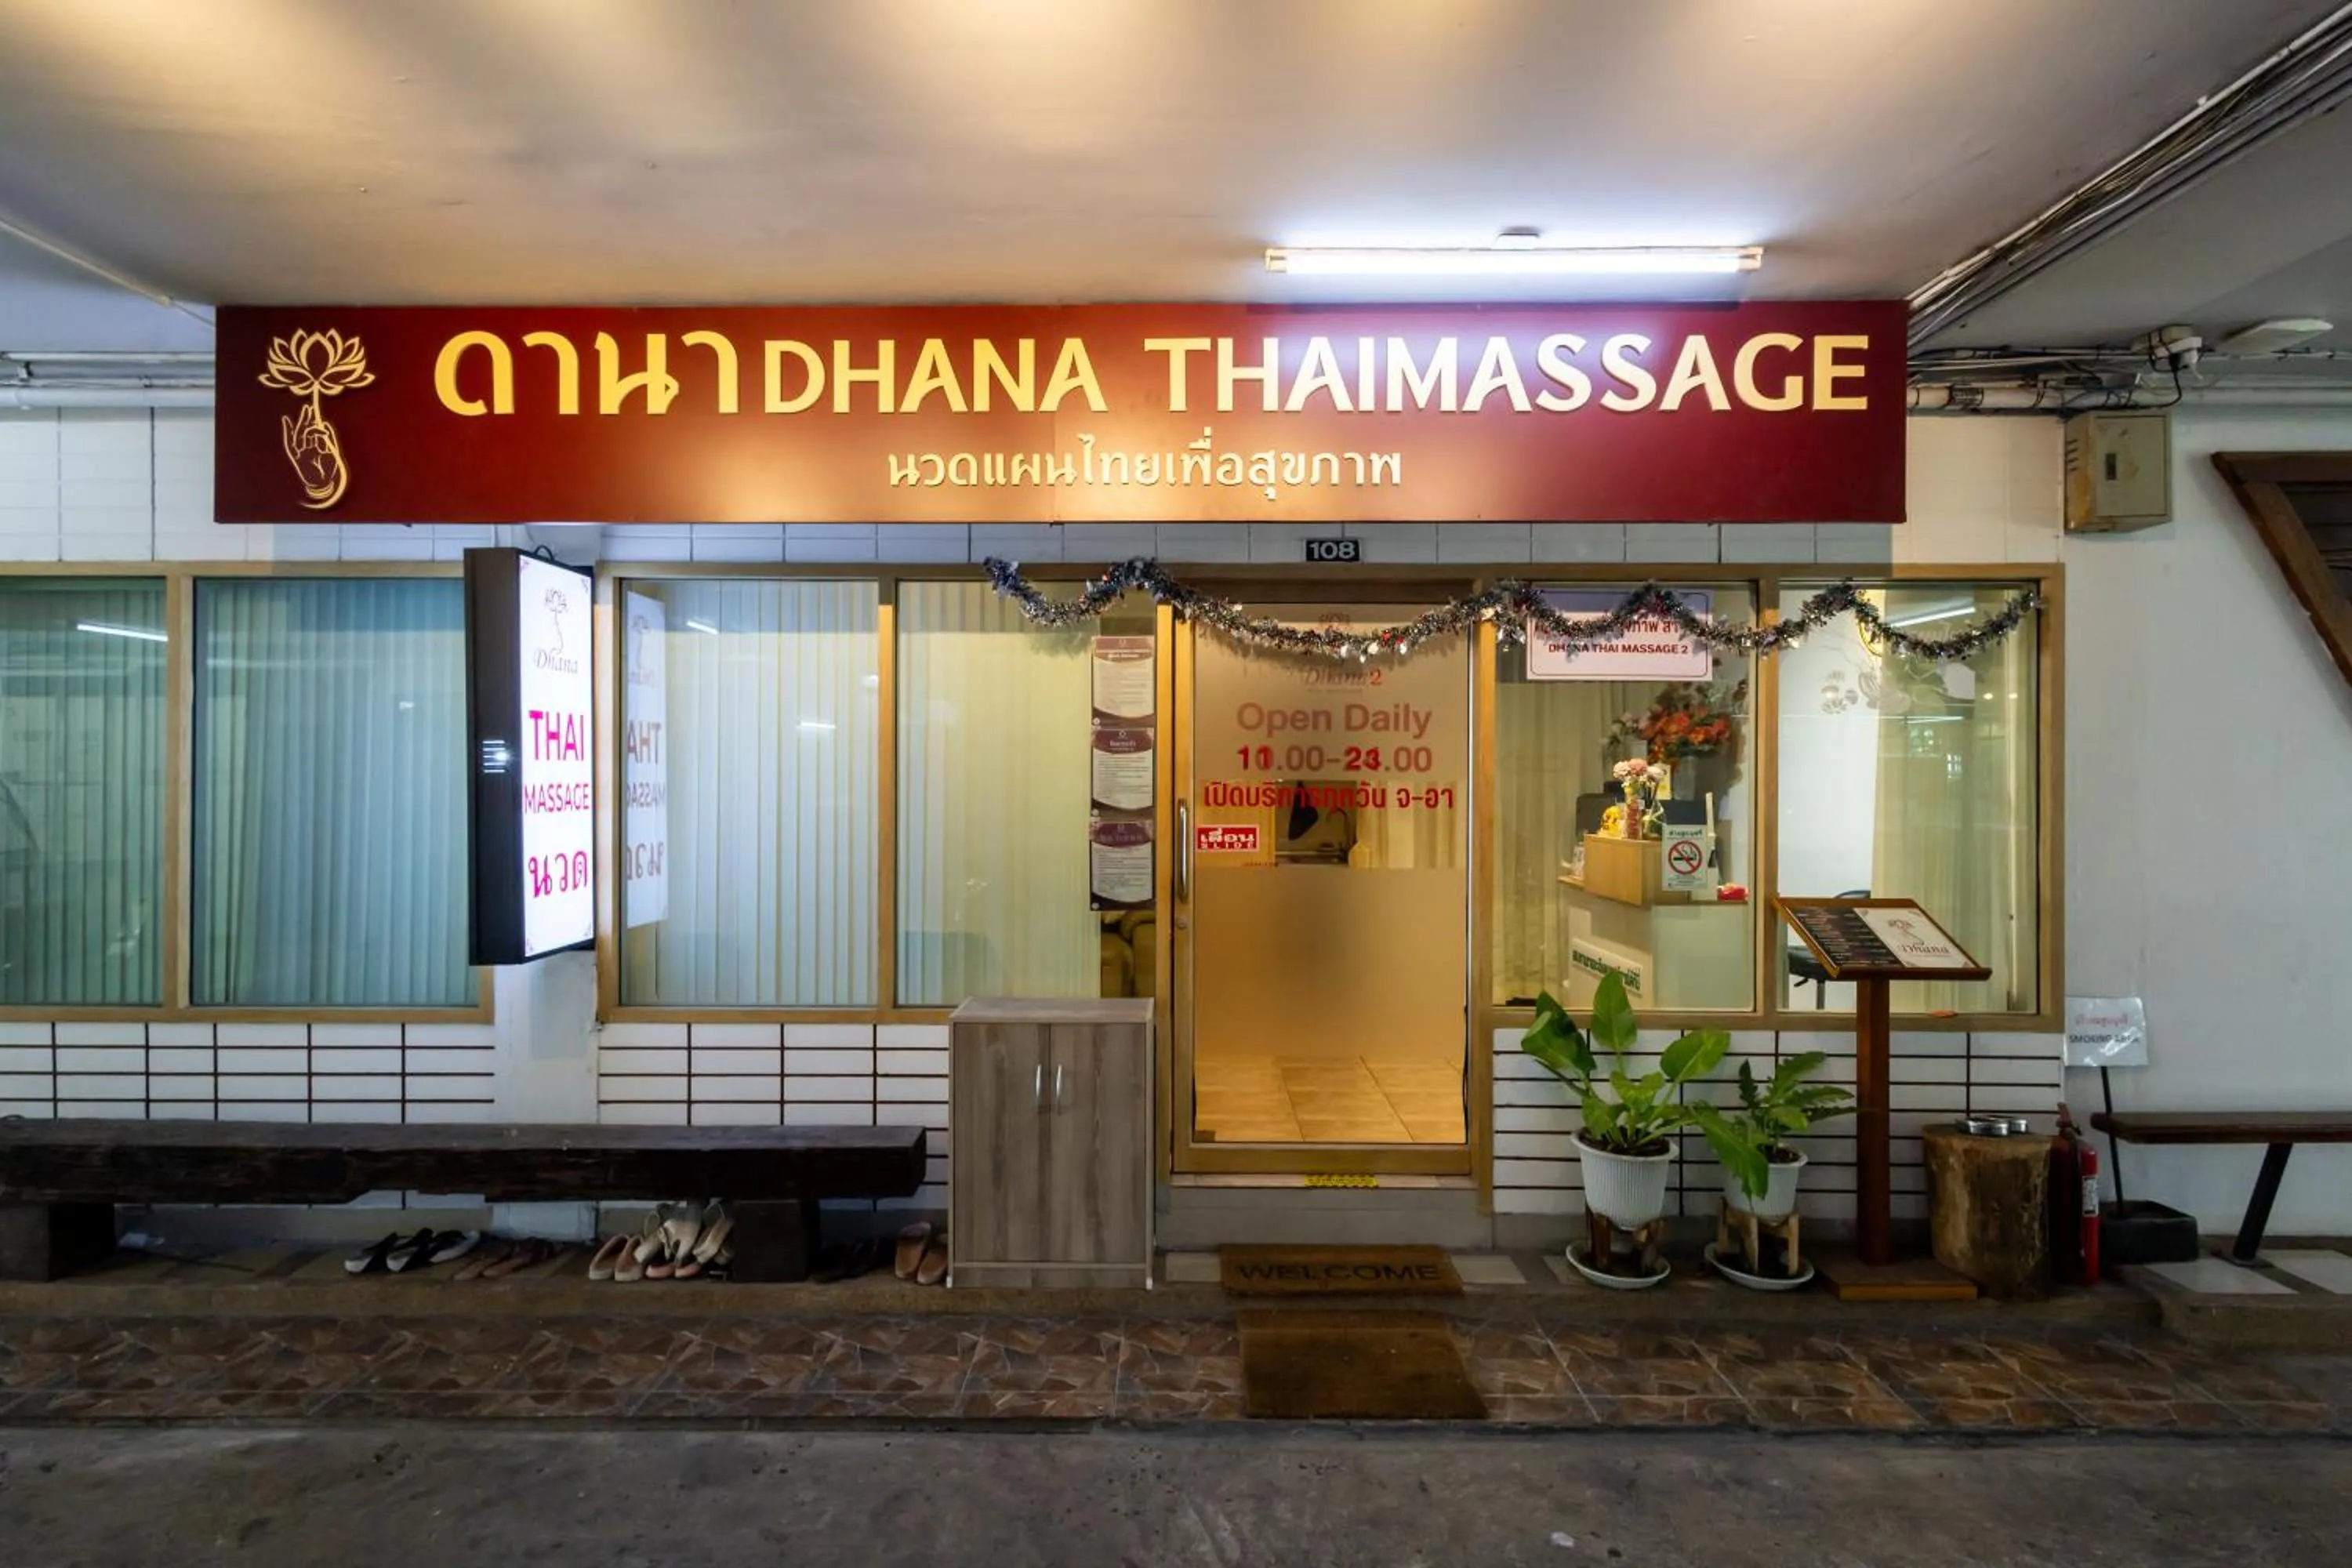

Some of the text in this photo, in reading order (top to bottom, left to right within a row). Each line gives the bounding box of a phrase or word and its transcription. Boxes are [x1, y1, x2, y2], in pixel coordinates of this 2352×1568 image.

[434, 330, 739, 416] ดานา
[764, 337, 1109, 414] DHANA
[888, 426, 1402, 501] นวดแผนไทยเพื่อสุขภาพ
[1309, 541, 1356, 559] 108
[1592, 644, 1619, 653] THAI
[1621, 644, 1679, 654] MASSAGE
[1680, 645, 1689, 655] 2
[1369, 669, 1382, 685] 2
[528, 710, 585, 760] THAI
[1236, 702, 1432, 739] Open Daily
[524, 783, 590, 814] MASSAGE
[528, 851, 588, 898] นวด
[1239, 1264, 1440, 1281] WELCOME
